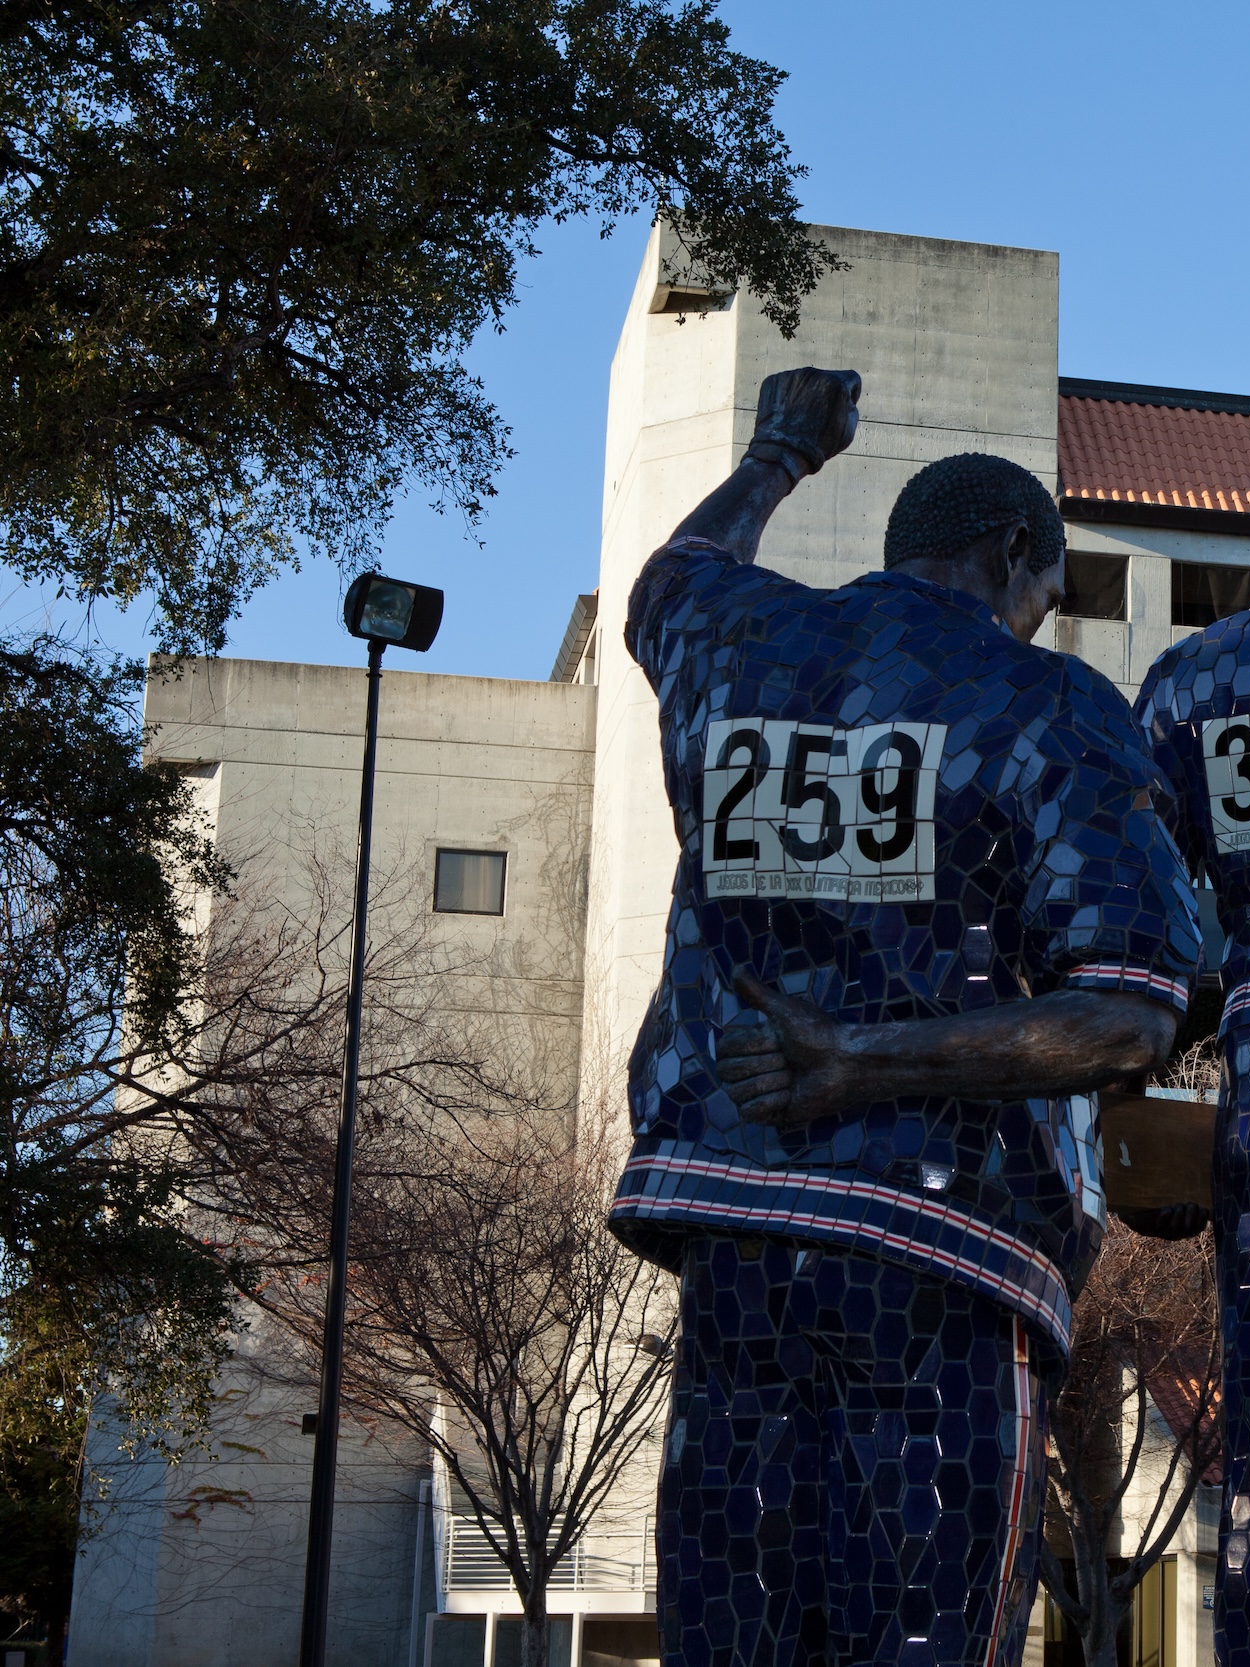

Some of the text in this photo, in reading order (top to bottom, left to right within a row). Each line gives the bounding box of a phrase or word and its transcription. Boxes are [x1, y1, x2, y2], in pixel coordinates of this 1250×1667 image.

[713, 728, 922, 863] 259
[770, 873, 782, 890] LA
[786, 876, 802, 892] XIX
